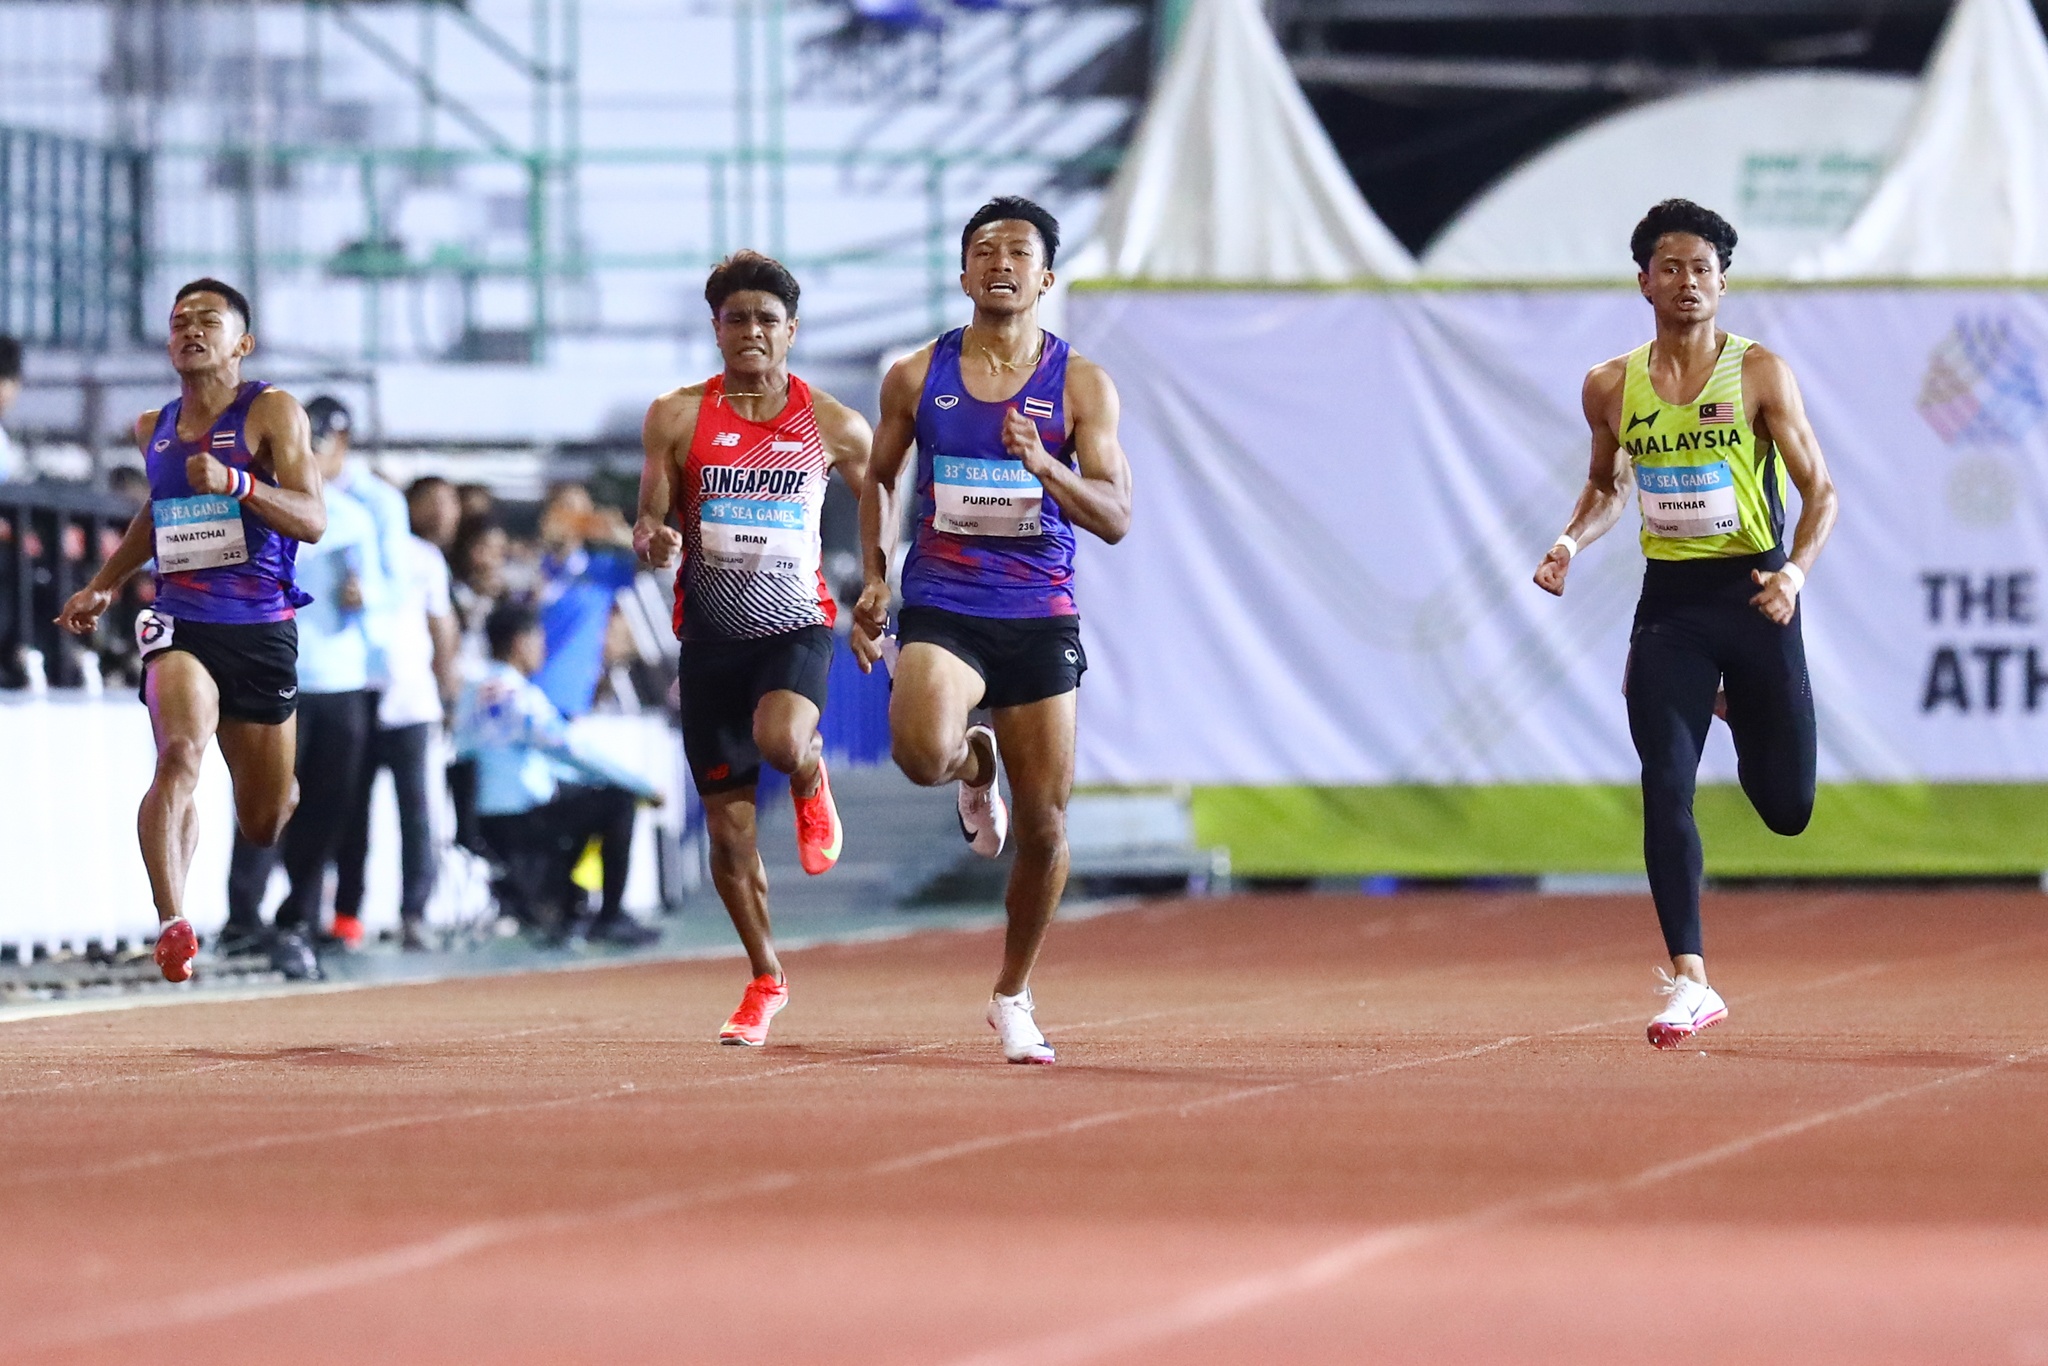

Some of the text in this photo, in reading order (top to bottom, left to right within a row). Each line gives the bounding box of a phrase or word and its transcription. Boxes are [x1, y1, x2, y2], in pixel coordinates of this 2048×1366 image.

[1626, 429, 1741, 456] MALAYSIA
[700, 466, 808, 494] SINGAPORE
[965, 467, 988, 480] SEA
[992, 469, 1033, 482] GAMES
[1657, 475, 1678, 487] SEA
[1681, 471, 1720, 487] GAMES
[963, 496, 1013, 506] PURIPOL
[1658, 500, 1706, 510] IFTIKHAR
[171, 505, 191, 519] SEA
[193, 501, 229, 517] GAMES
[731, 506, 753, 519] SEA
[756, 508, 795, 522] GAMES
[1018, 522, 1035, 531] 236
[1715, 519, 1733, 529] 140
[166, 529, 225, 543] THAWATCHAI
[735, 534, 767, 544] BRIAN
[223, 551, 241, 560] 242
[776, 560, 794, 569] 219
[1920, 569, 2035, 625] THE
